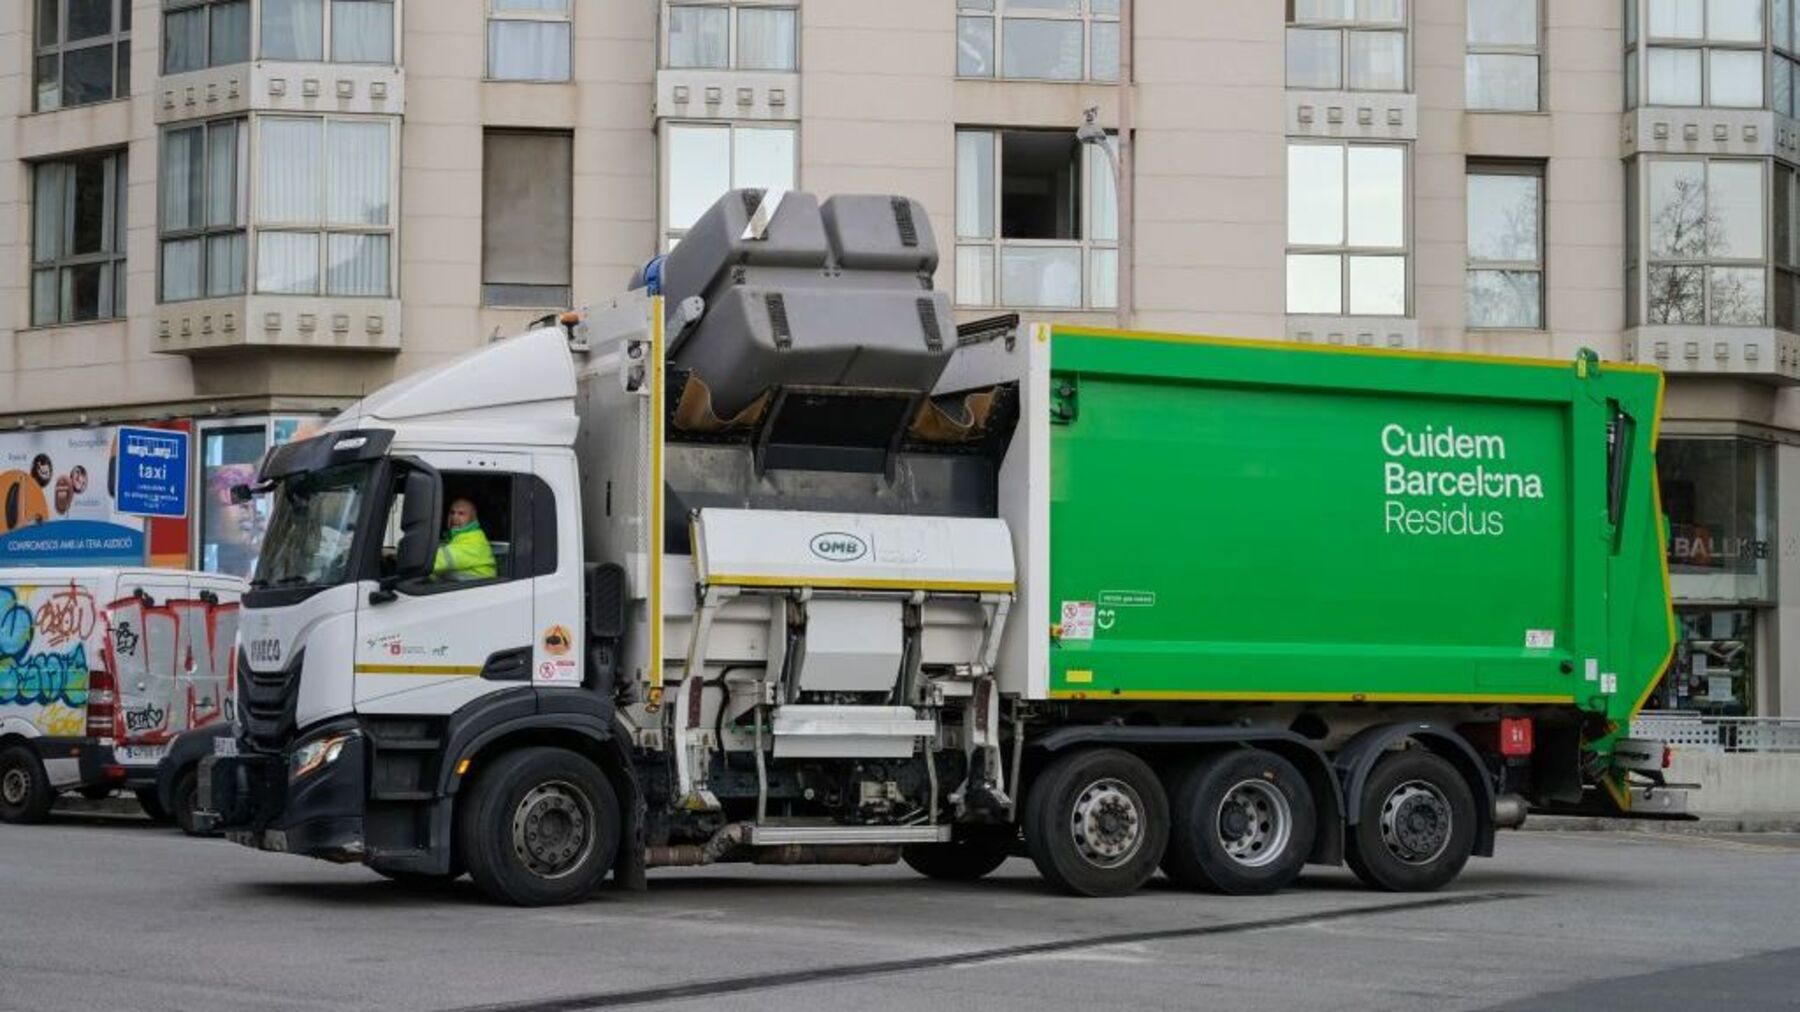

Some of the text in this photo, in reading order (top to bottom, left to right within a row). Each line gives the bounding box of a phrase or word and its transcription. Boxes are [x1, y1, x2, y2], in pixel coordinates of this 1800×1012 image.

[1381, 423, 1506, 460] Cuidem
[138, 462, 167, 480] taxi
[1384, 462, 1545, 499] Barcelona
[1385, 500, 1505, 536] Residus
[818, 541, 857, 553] OMB
